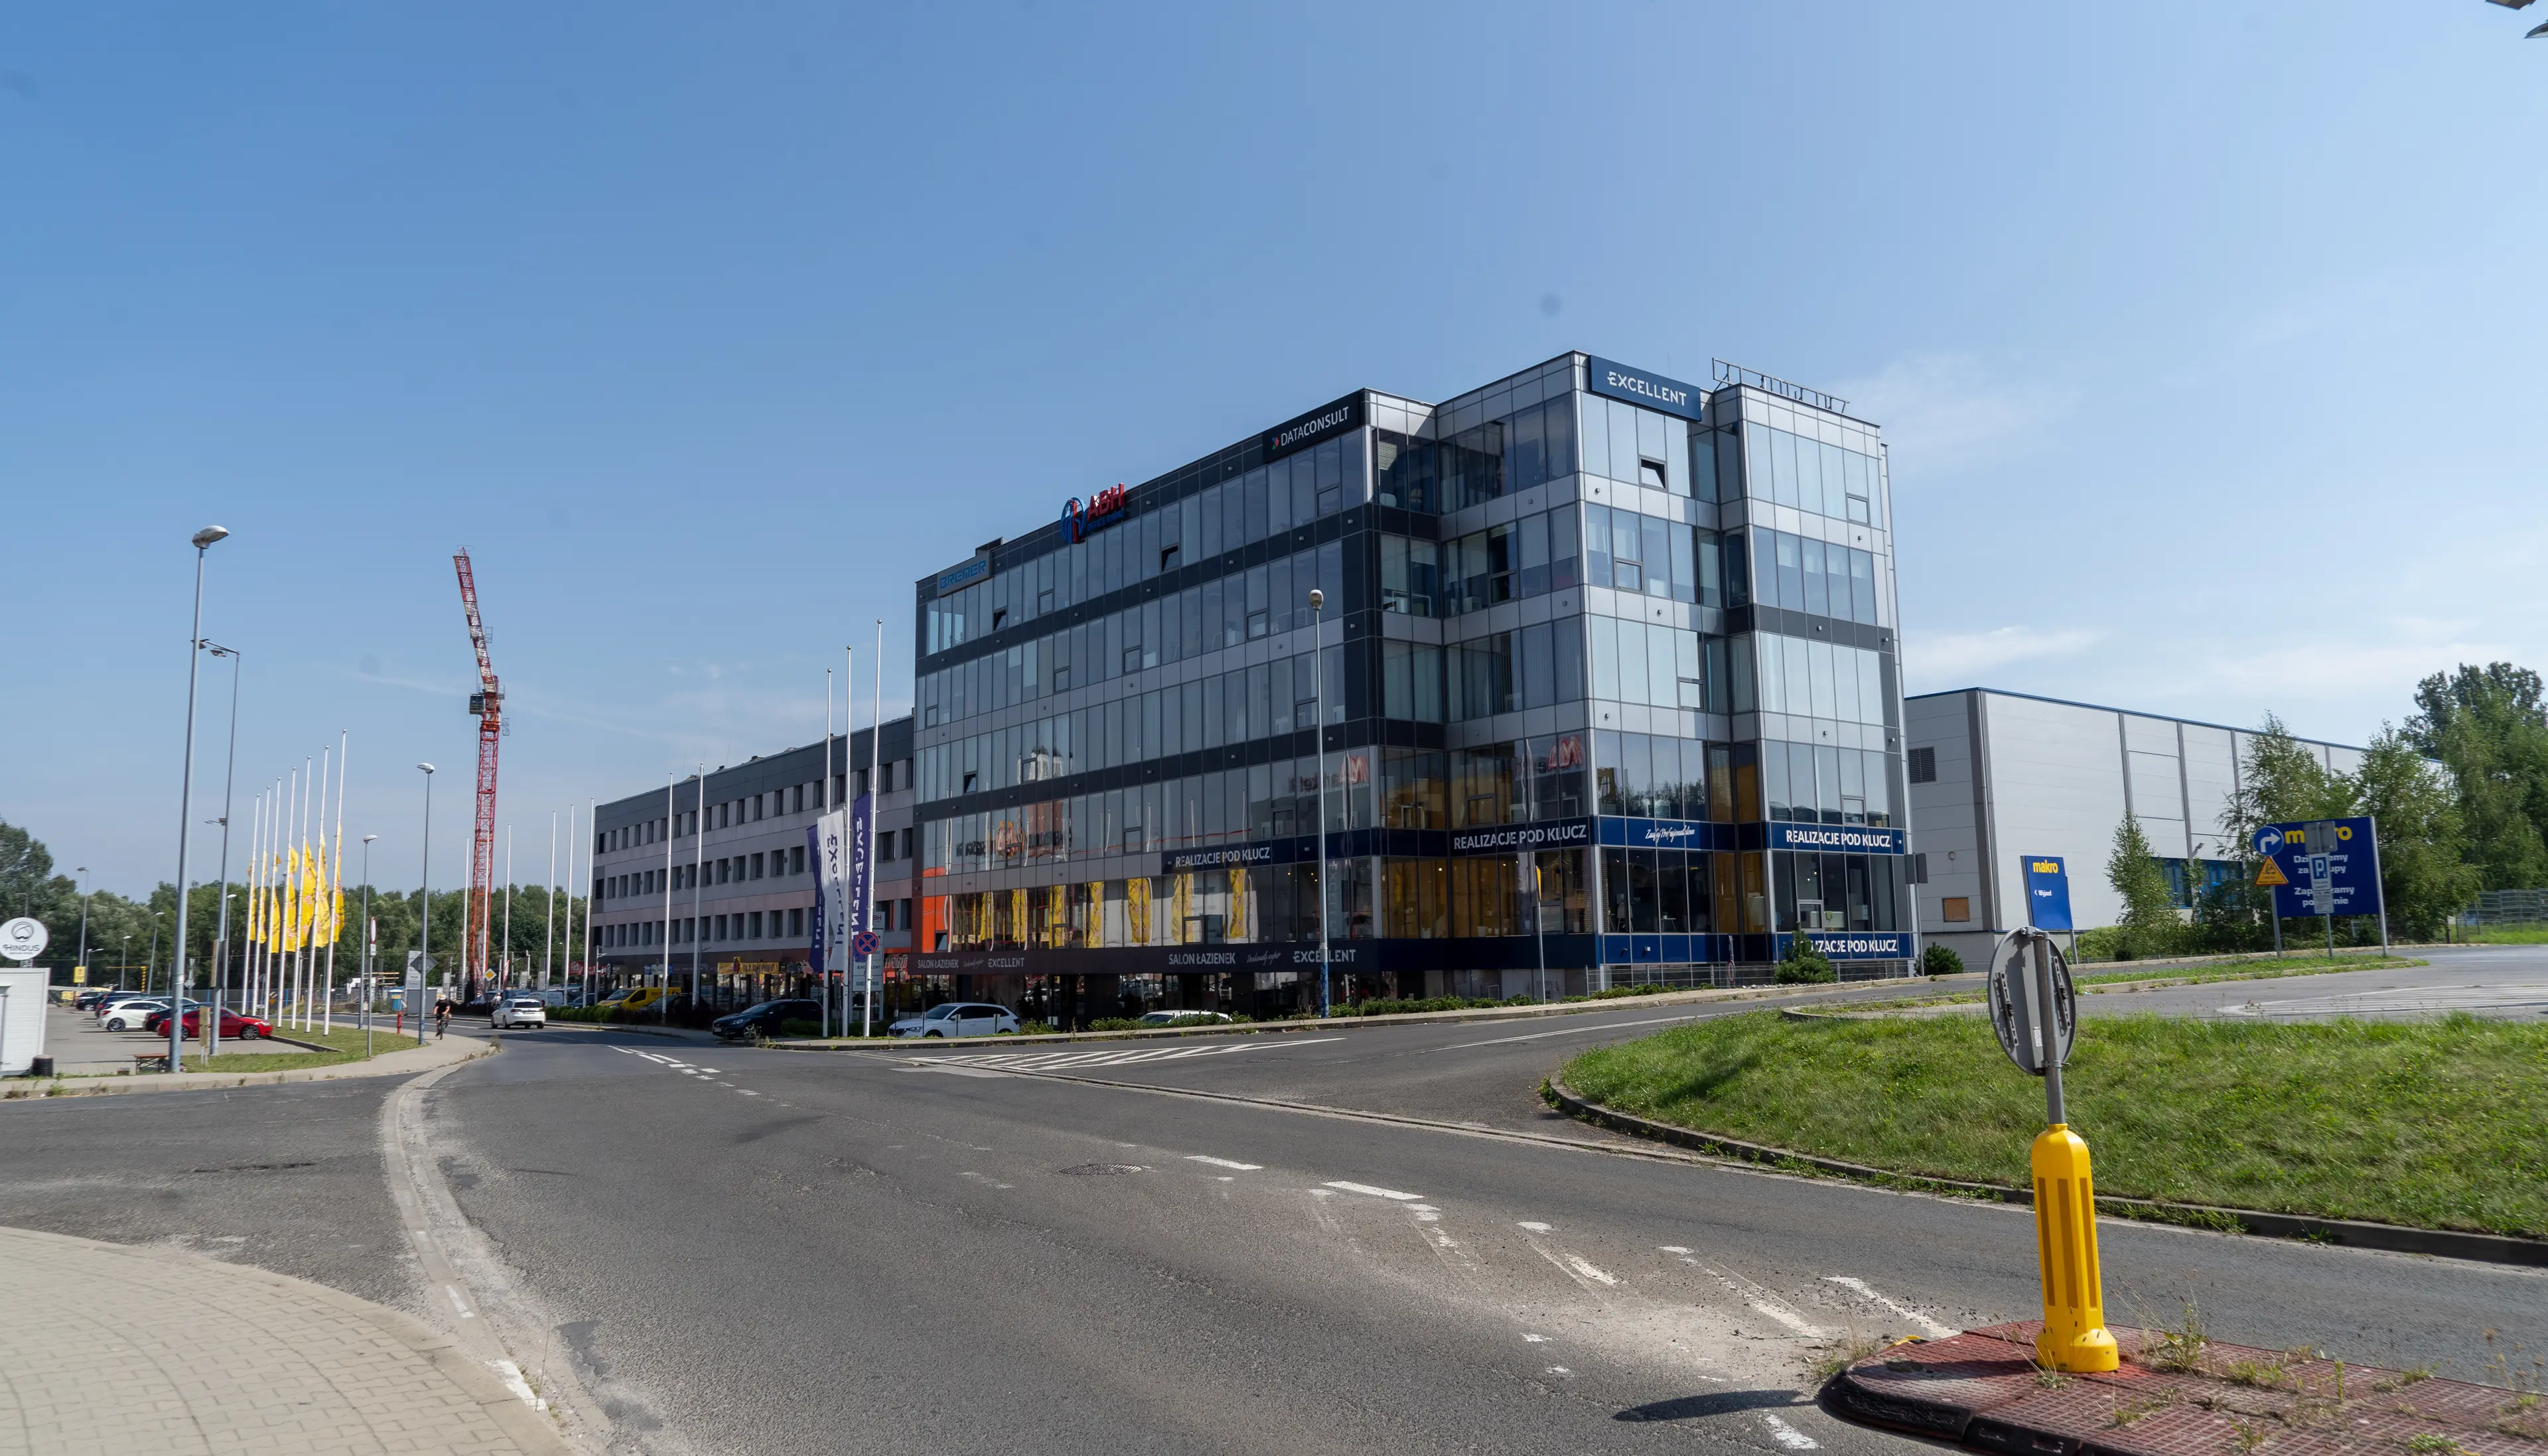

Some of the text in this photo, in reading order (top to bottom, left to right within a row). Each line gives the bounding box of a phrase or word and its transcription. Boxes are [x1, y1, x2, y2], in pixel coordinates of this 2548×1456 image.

[1607, 371, 1687, 406] EXCELLENT
[1281, 406, 1349, 446] DATACONSULT
[1087, 483, 1125, 522] ABH
[940, 560, 986, 589] BREMER
[1454, 825, 1587, 850] REALIZACJE POD KLUCZ
[1786, 830, 1891, 847] REALIZACJE POD KLUCZ
[1176, 846, 1270, 868] REALIZACJE POD KLUCZ
[2032, 860, 2058, 873] makro
[1168, 953, 1195, 964] SALON
[1196, 952, 1236, 964] ŁAZIENEK
[1293, 949, 1356, 962] EXCELENT
[1848, 940, 1867, 952] POD
[1869, 939, 1897, 952] KLUCZ
[918, 959, 934, 968] SALON
[934, 959, 959, 968] ŁAZIENEK
[987, 957, 1025, 968] EXCELLENT
